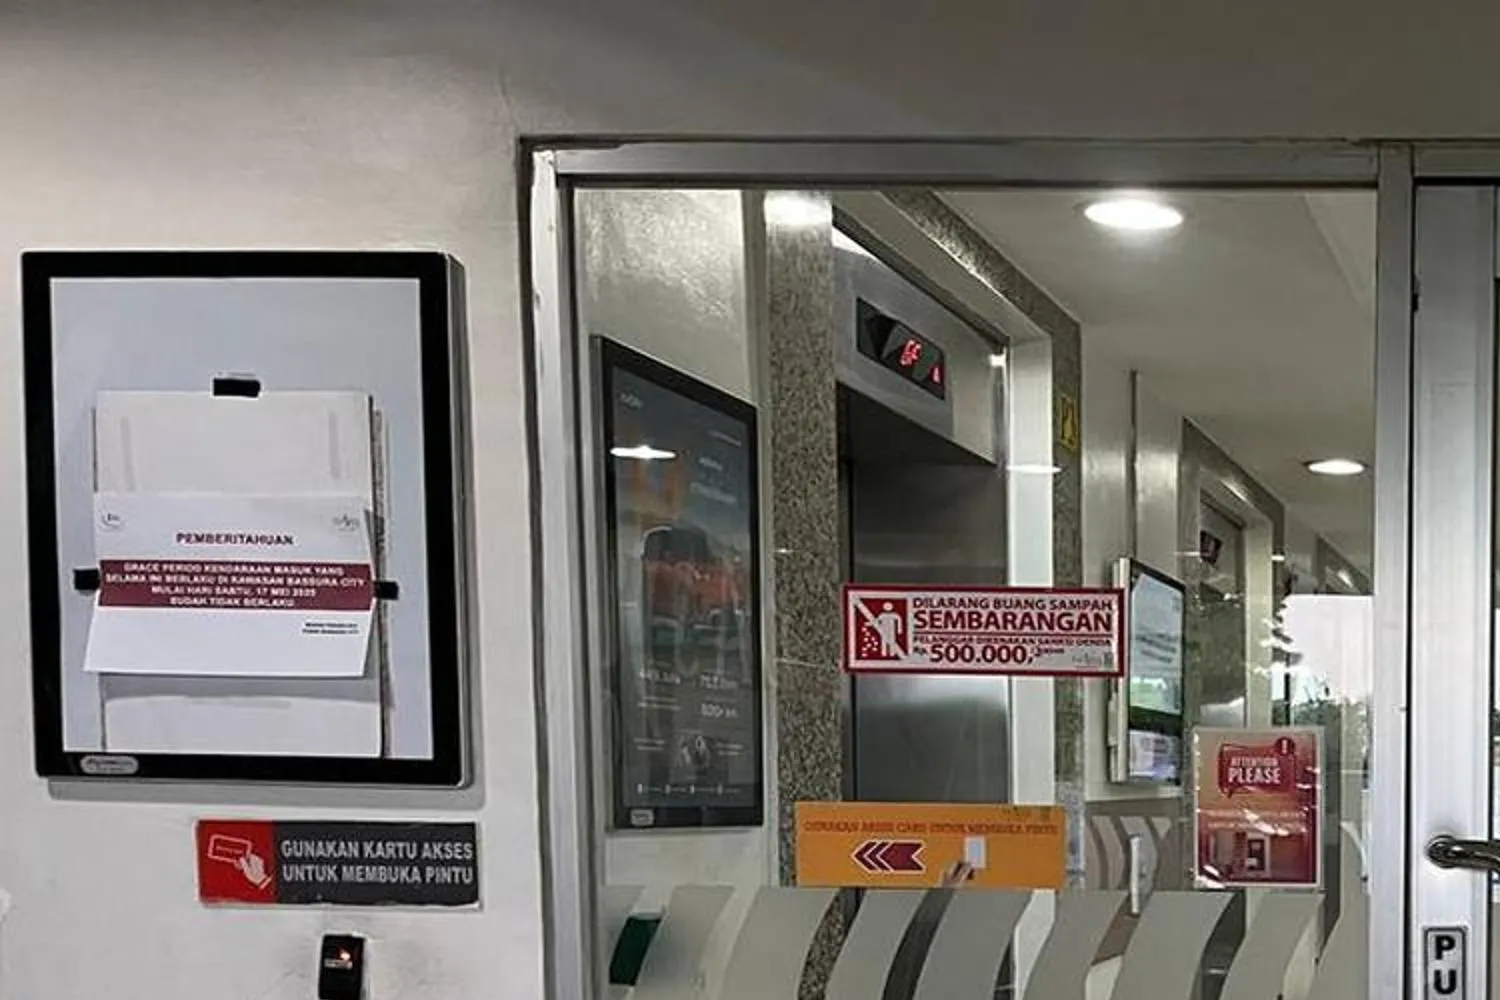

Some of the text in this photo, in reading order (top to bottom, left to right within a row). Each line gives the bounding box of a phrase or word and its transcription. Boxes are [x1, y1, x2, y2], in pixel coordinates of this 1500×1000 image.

[176, 532, 294, 546] PEMBERITAHUAN
[912, 598, 1113, 611] DILARANG BUANG SAMPAH
[913, 610, 1112, 632] SEMBARANGAN
[1231, 756, 1279, 767] ATTENTION
[1228, 767, 1281, 784] PLEASE
[281, 840, 473, 860] GUNAKAN KARTU AKSES
[282, 864, 473, 884] UNTUK MEMBUKA PINTU
